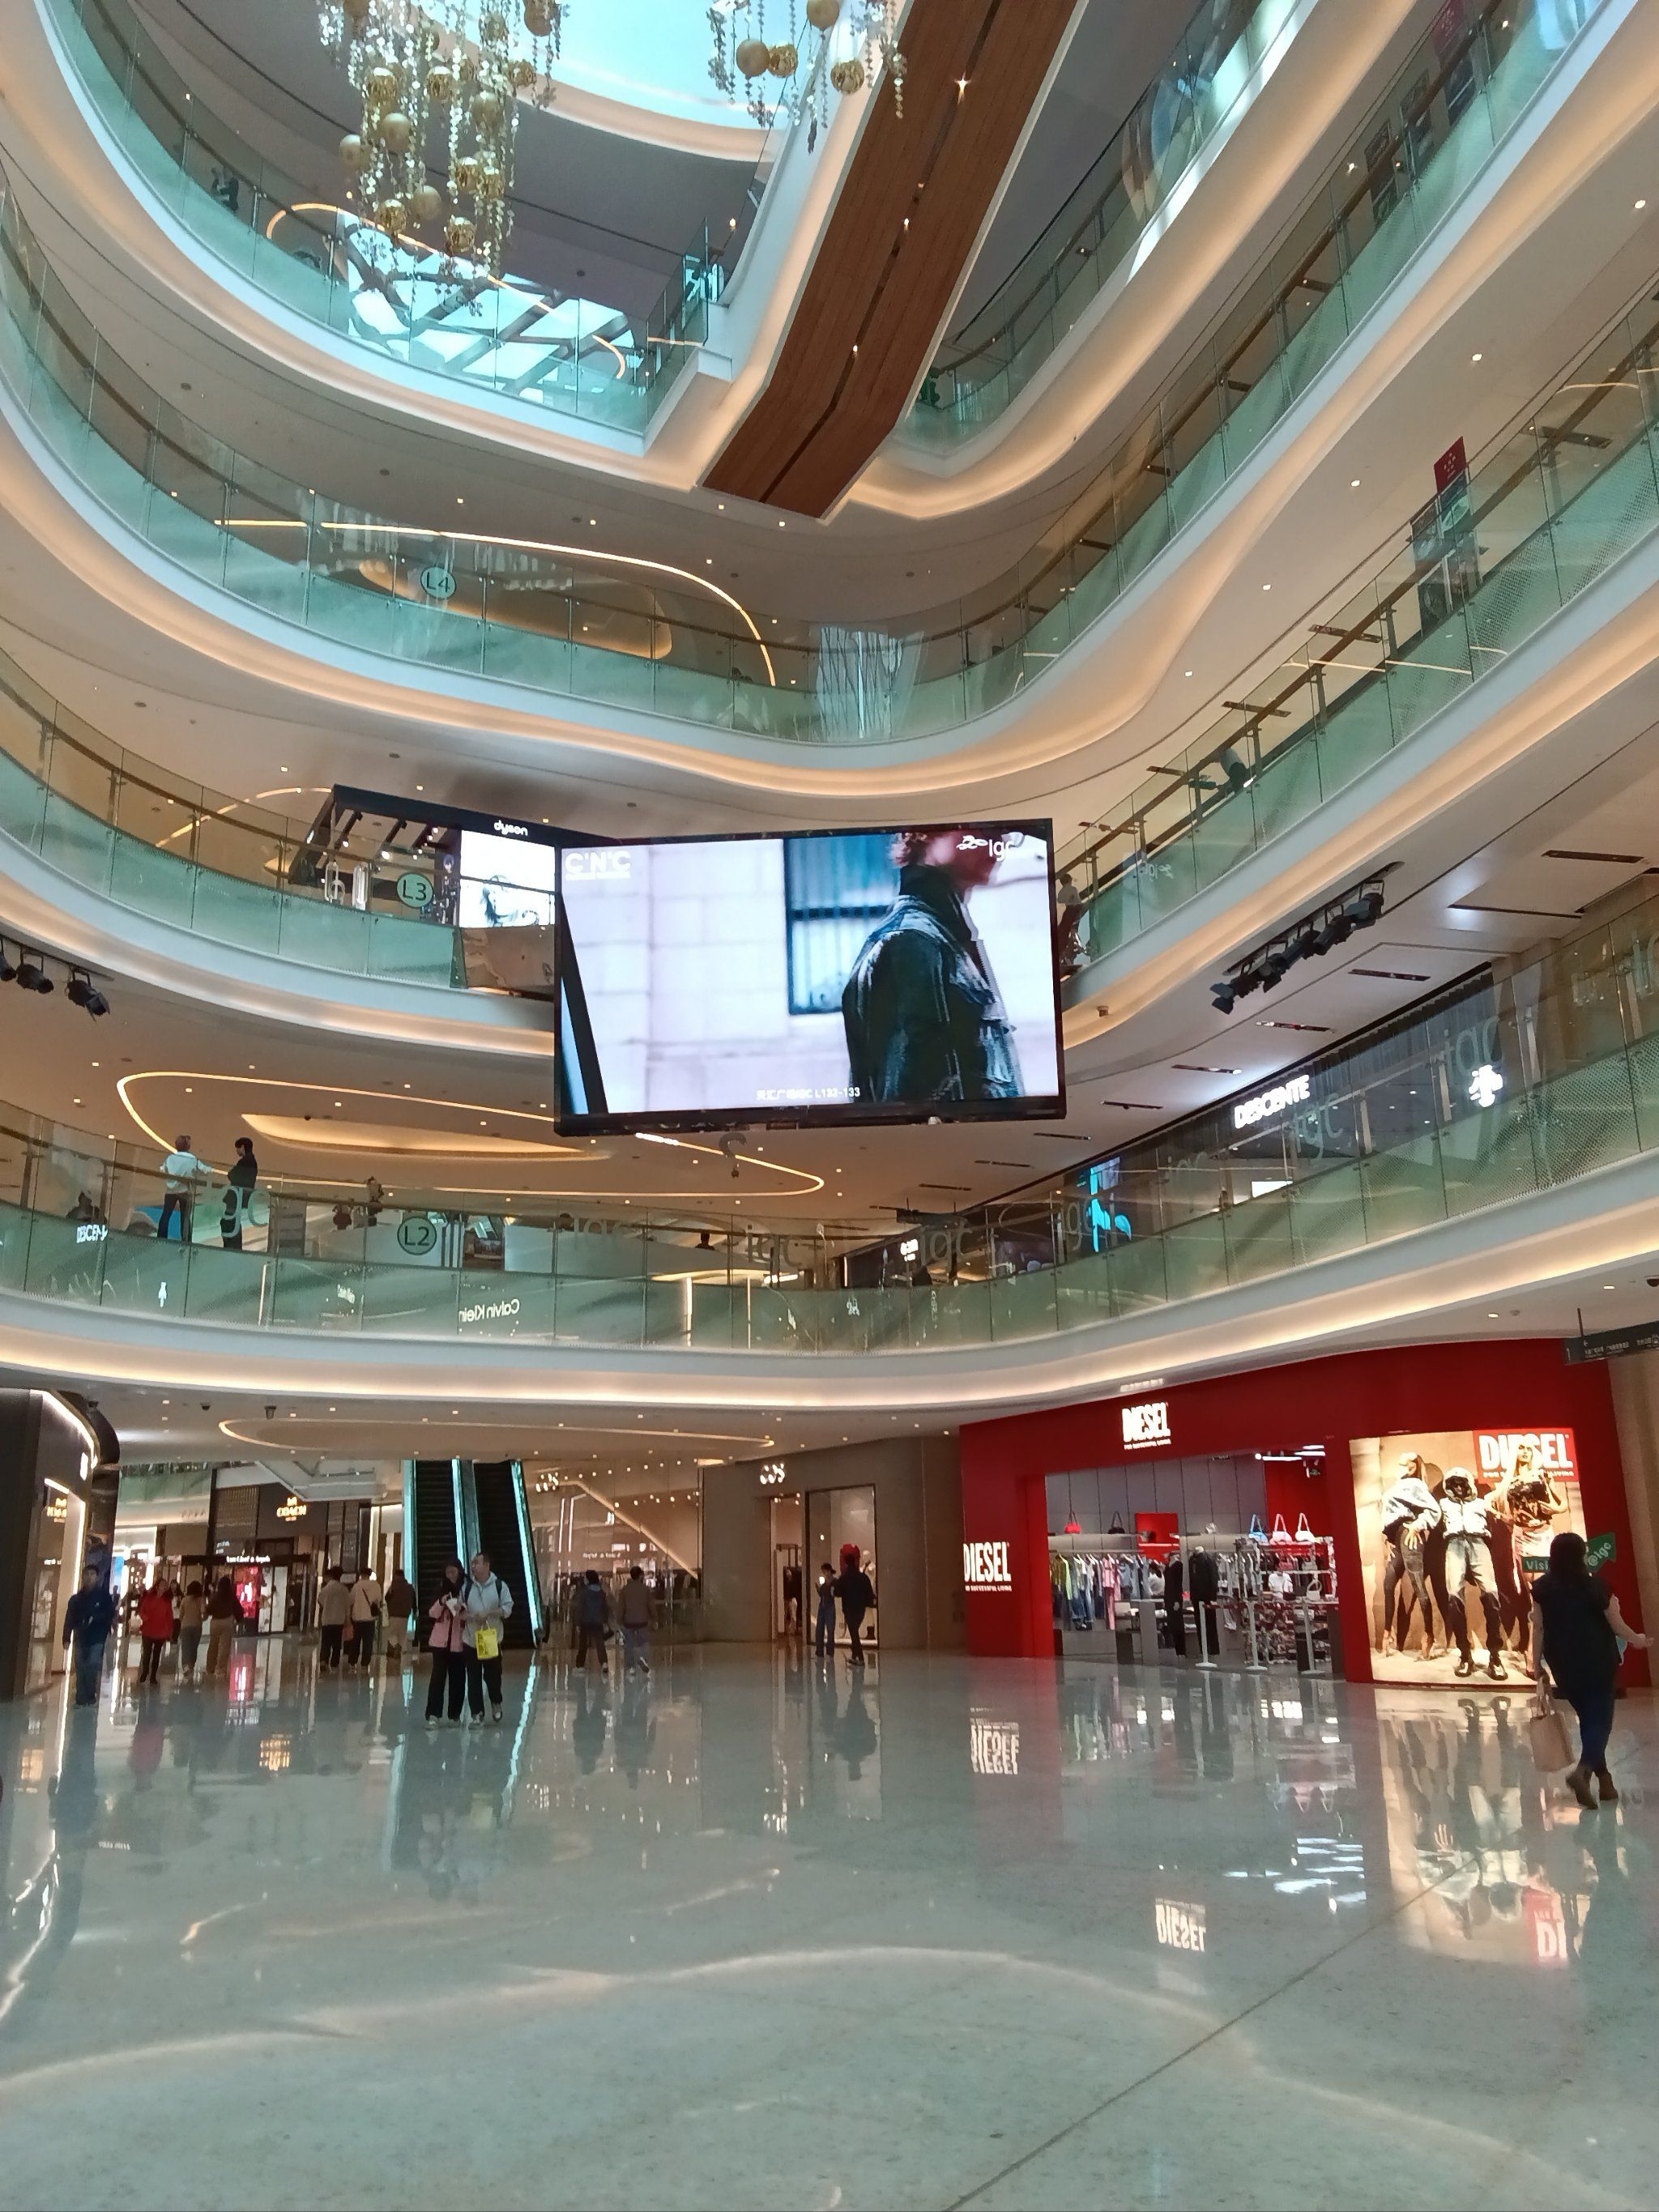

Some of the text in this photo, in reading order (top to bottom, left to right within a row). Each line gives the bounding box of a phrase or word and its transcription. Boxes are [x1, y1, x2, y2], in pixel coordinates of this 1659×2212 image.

[426, 572, 450, 593] L4
[493, 820, 528, 837] dyson
[402, 879, 427, 901] L3
[404, 1225, 430, 1246] L2
[276, 1505, 307, 1519] COACH
[962, 1541, 1012, 1583] DIESEL
[1526, 1559, 1550, 1571] Visi
